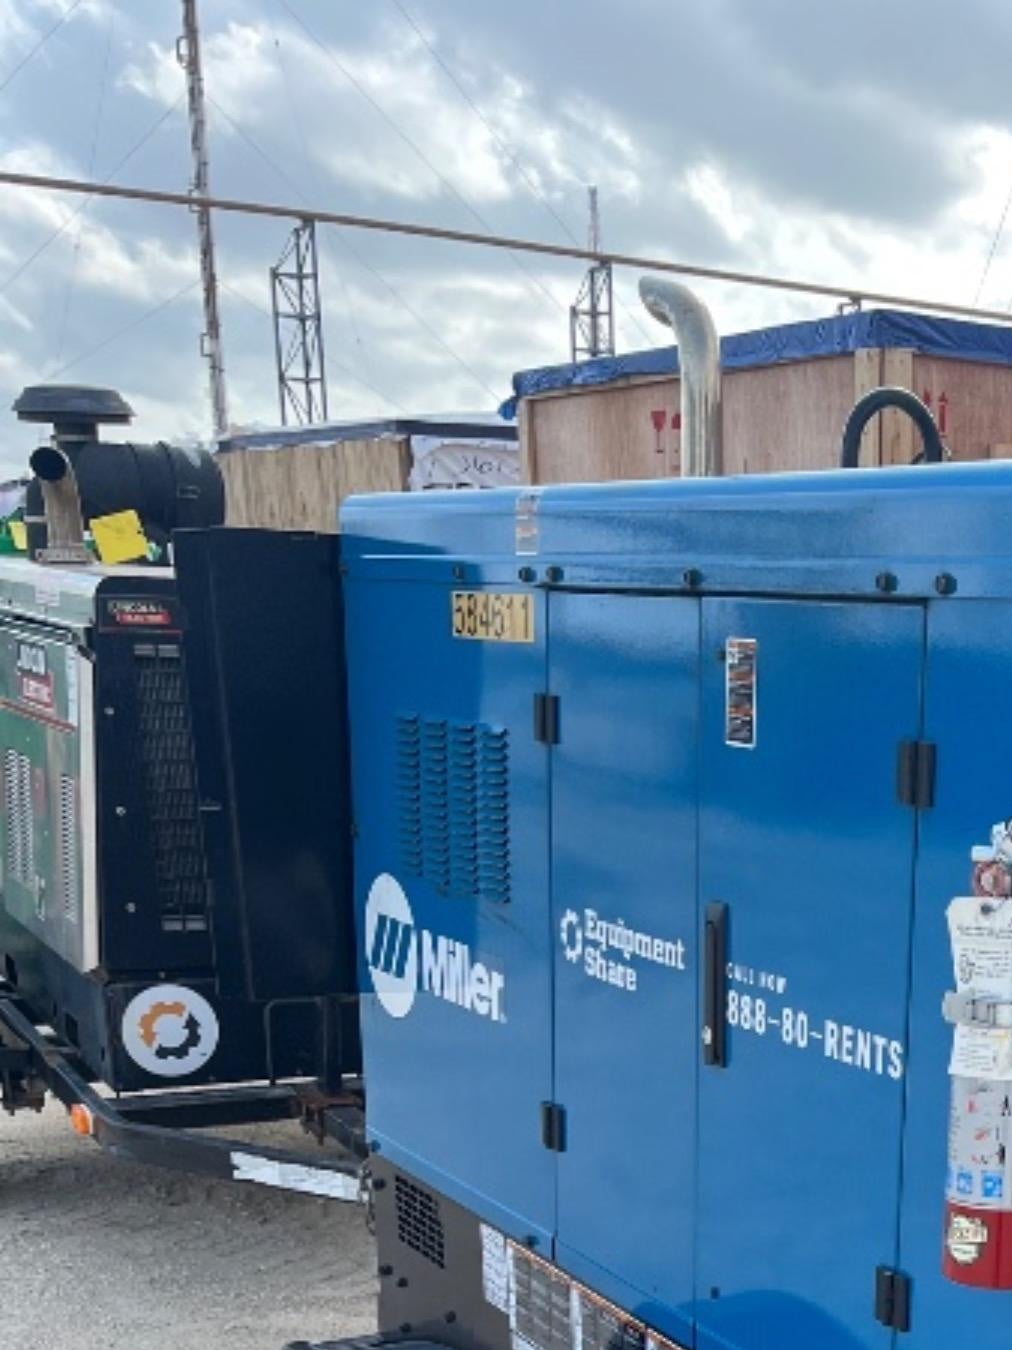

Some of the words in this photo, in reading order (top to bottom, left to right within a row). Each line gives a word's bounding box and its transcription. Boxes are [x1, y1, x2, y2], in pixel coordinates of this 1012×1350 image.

[421, 928, 506, 1022] Miller
[583, 907, 686, 970] Equipment
[583, 944, 637, 991] Share
[726, 988, 904, 1081] 888-80-RENTS
